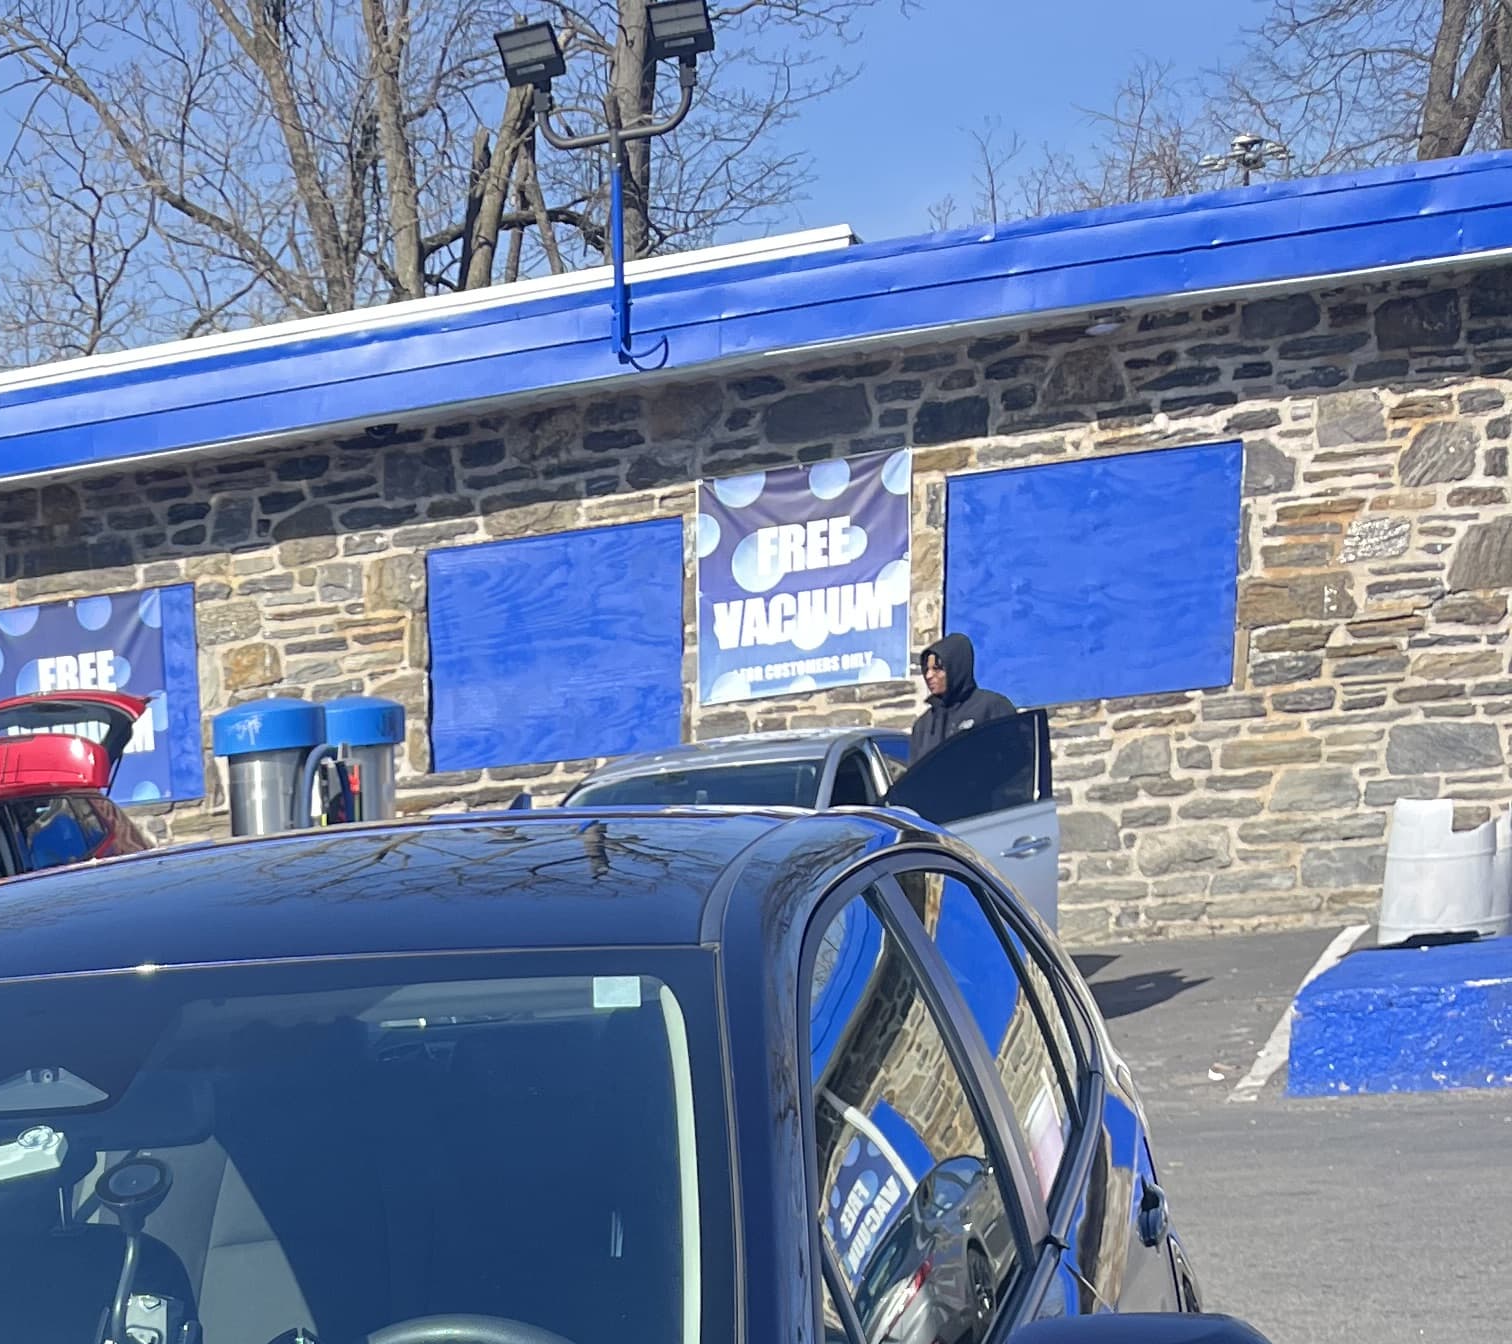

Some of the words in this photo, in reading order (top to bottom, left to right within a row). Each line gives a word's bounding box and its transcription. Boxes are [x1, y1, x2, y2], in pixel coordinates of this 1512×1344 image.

[756, 516, 852, 577] FREE
[713, 582, 894, 650] VACUUM
[37, 649, 117, 691] FREE
[764, 655, 840, 680] CUSTOMERS
[841, 651, 874, 670] ONLY
